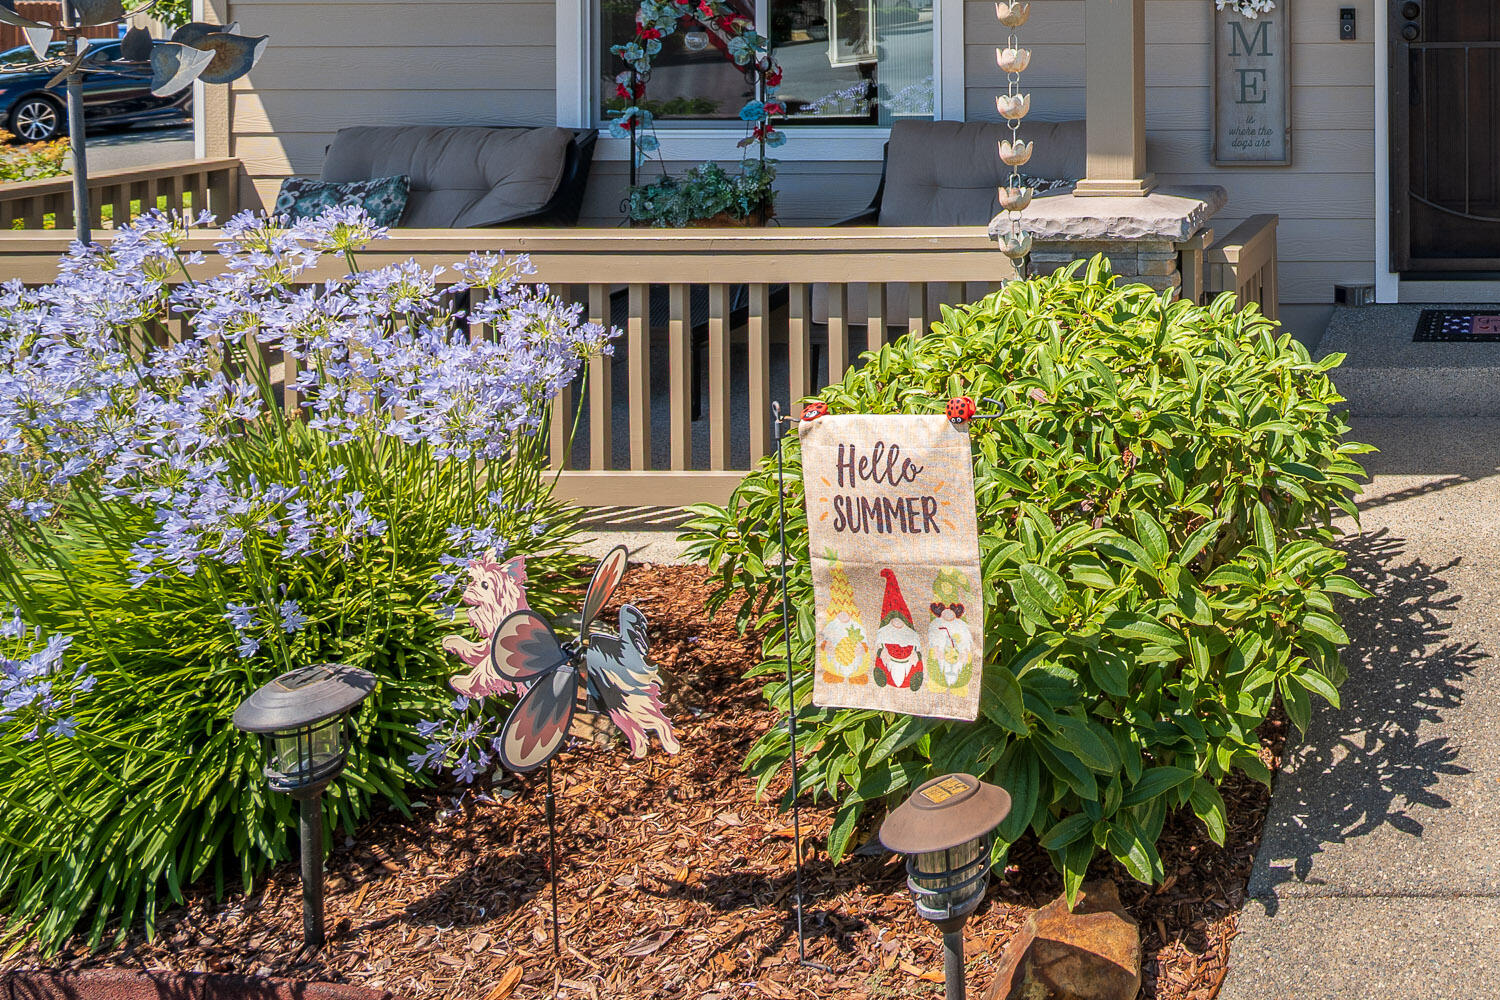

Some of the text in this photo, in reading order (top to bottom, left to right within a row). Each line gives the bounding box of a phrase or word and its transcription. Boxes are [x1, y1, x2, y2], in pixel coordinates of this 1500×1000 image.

[1228, 124, 1274, 136] where the
[1231, 138, 1271, 150] dogs are
[836, 441, 923, 488] Hello
[834, 495, 940, 534] SUMMER
